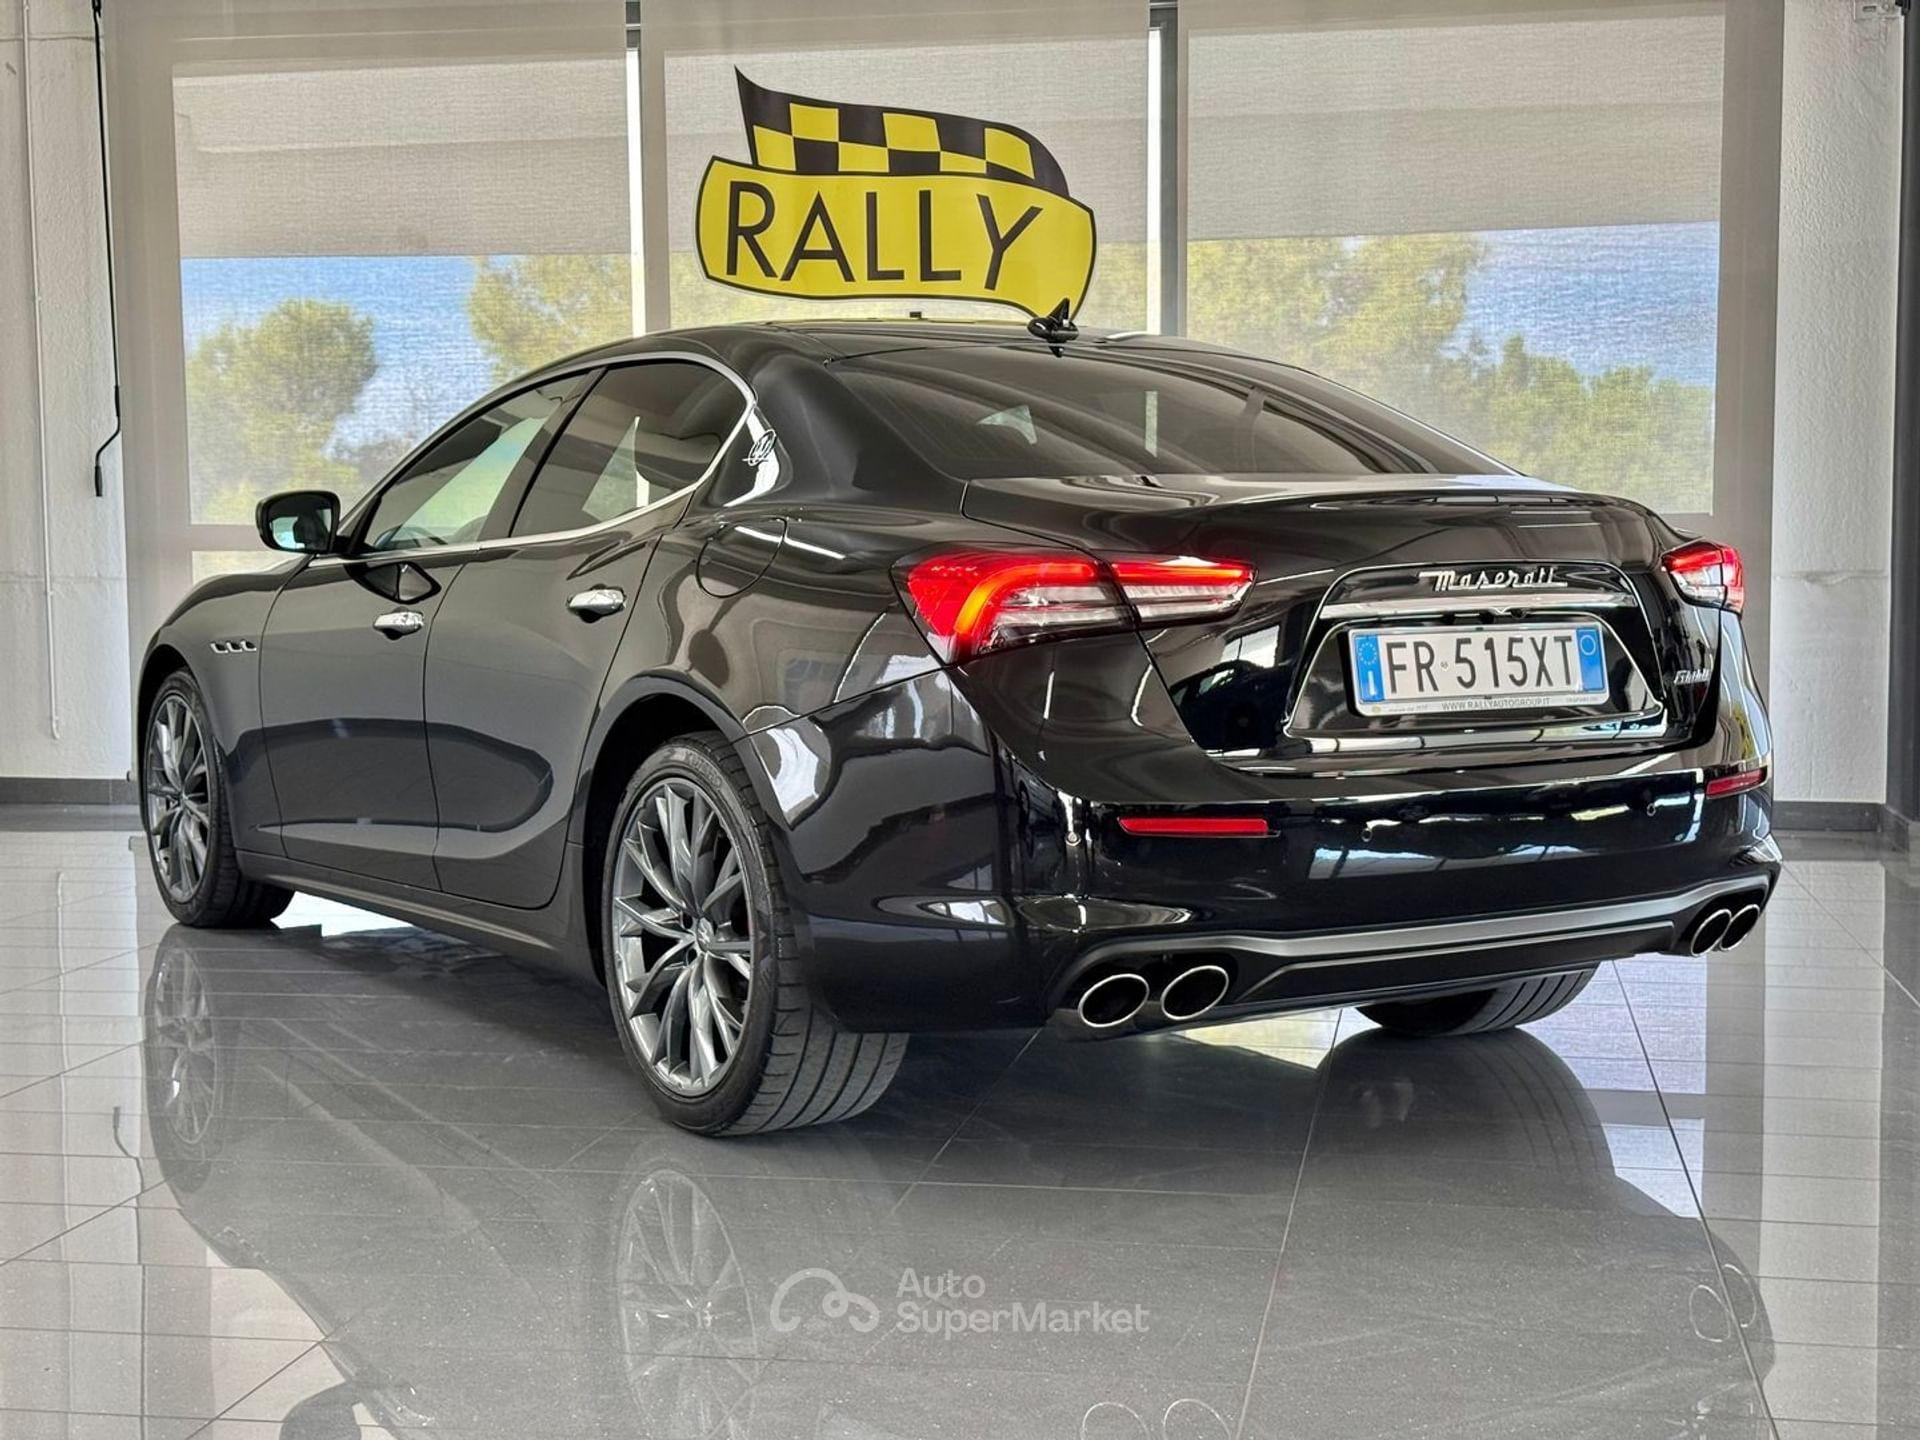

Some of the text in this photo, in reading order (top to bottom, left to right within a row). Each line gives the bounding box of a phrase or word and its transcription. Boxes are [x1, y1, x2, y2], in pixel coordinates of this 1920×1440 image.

[725, 180, 1044, 291] RALLY
[1418, 567, 1568, 592] Maserati
[1386, 635, 1572, 694] FR 515XT
